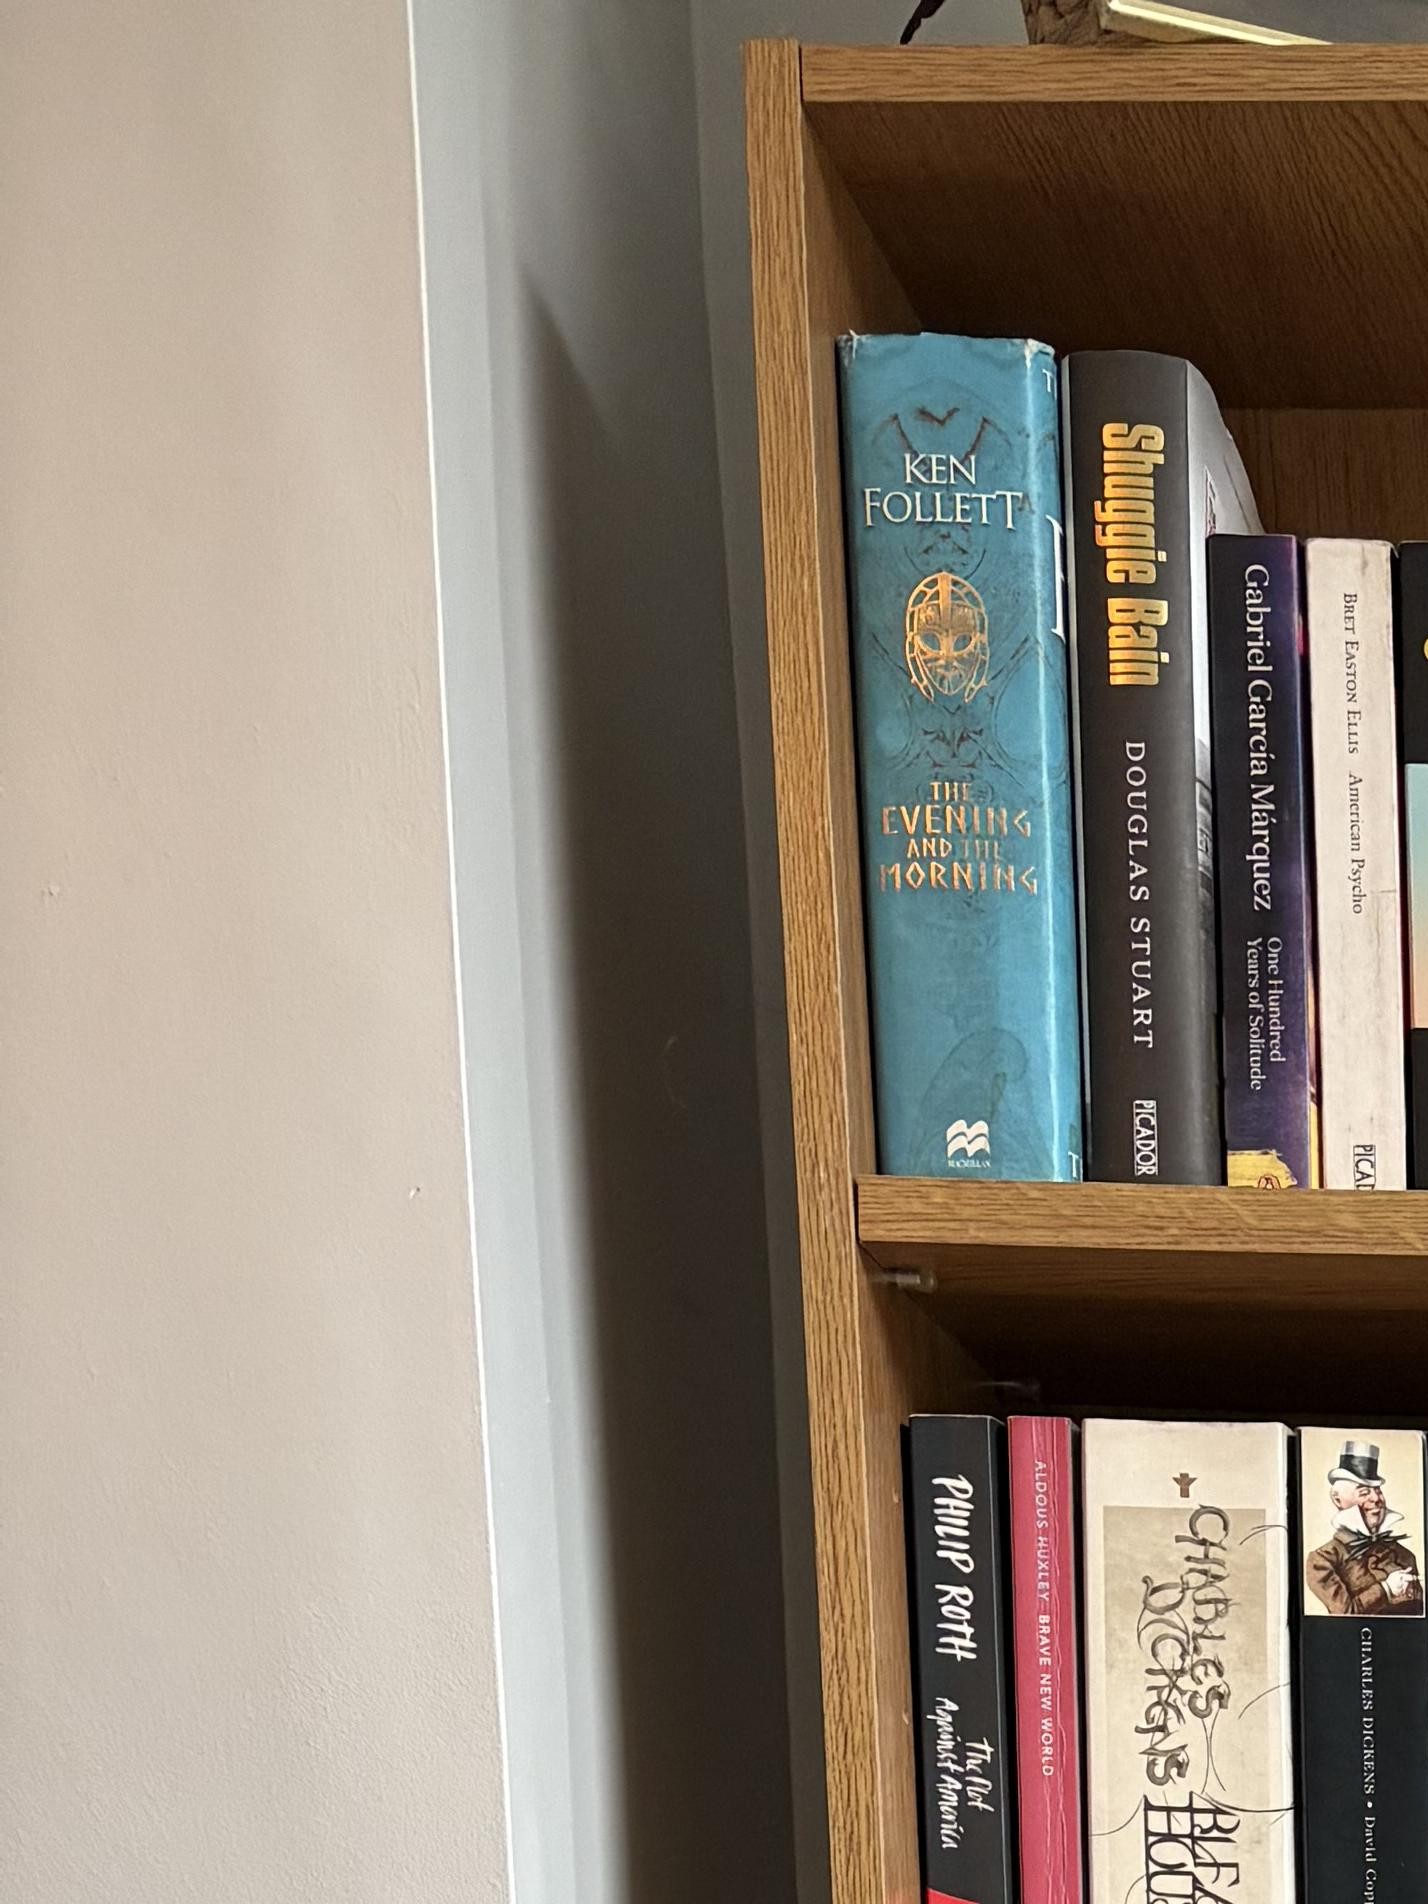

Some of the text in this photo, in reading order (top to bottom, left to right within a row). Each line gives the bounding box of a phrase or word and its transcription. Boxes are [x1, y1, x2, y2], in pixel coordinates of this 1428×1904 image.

[864, 487, 1020, 529] FOLLETT
[904, 453, 977, 485] KEN
[1094, 423, 1171, 687] Shuggie Bain
[1124, 741, 1154, 1048] DOUGLAS STUART
[932, 1474, 977, 1661] PHILIP ROTH
